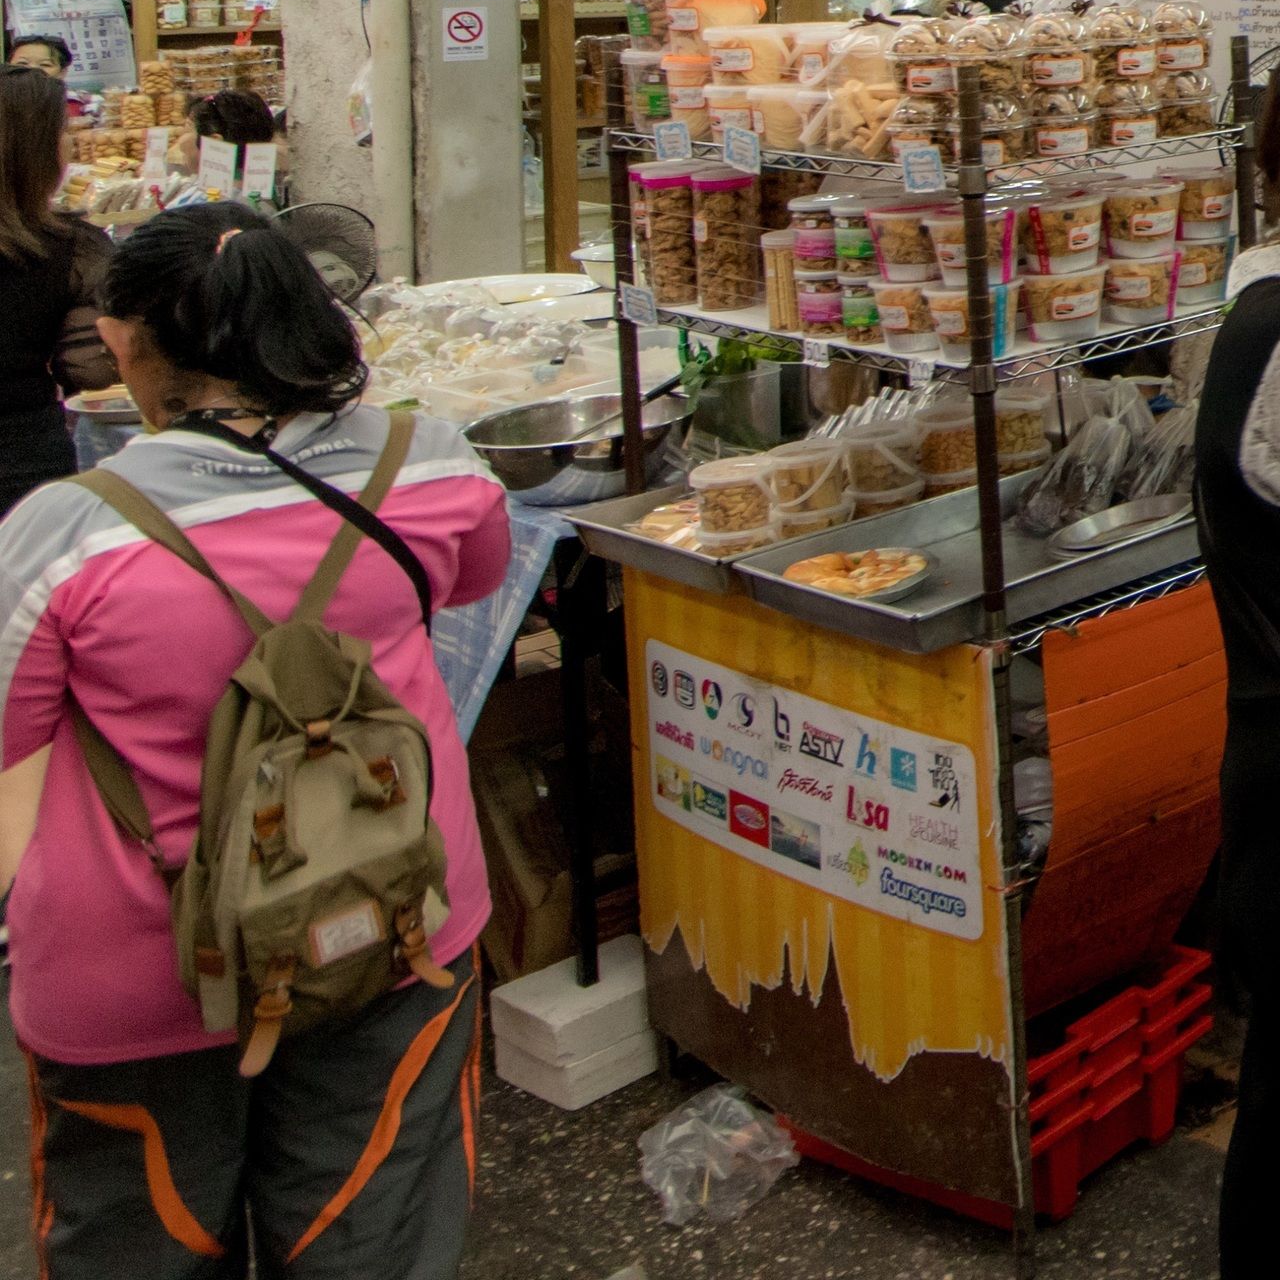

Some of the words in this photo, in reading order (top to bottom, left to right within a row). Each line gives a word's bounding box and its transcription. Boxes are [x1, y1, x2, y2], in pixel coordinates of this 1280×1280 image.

[799, 731, 844, 766] ASTV
[908, 812, 959, 837] HEALTH
[880, 867, 967, 918] foursquare
